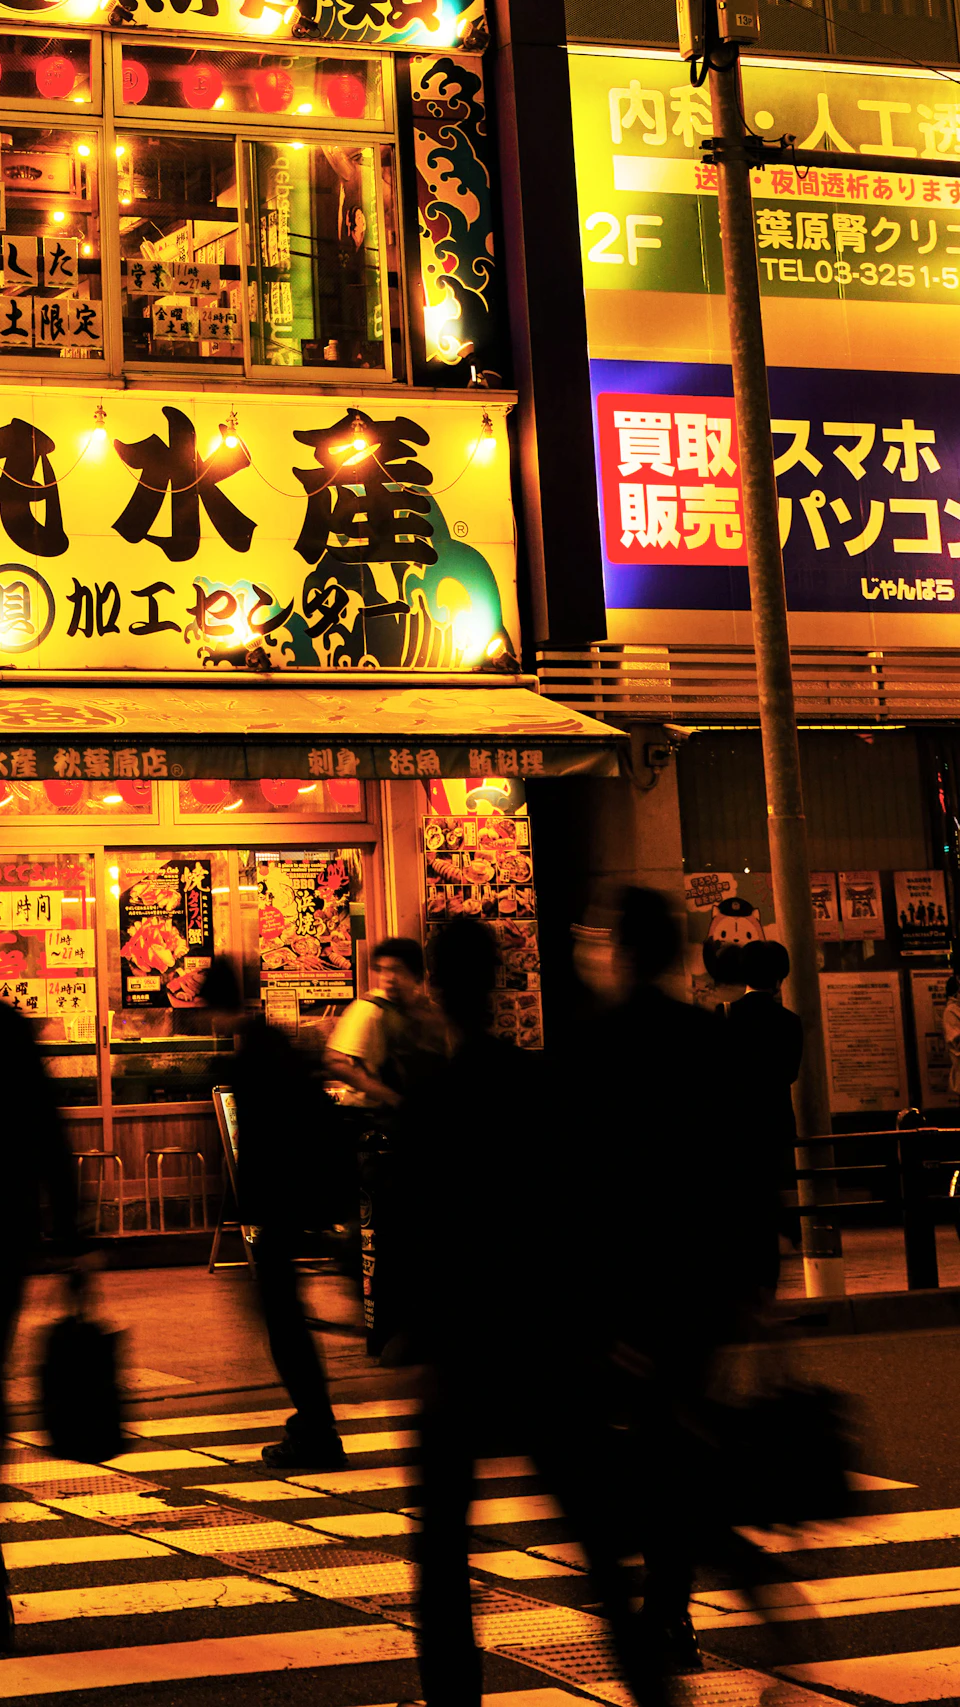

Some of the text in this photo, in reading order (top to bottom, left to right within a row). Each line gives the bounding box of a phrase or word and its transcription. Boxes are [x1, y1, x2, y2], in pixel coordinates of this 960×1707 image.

[695, 164, 960, 204] 送・夜間透析あります
[584, 211, 664, 266] 2F
[131, 262, 167, 290] 営業
[154, 307, 184, 321] 金曜
[201, 311, 238, 324] 24時間
[164, 321, 193, 335] 土曜
[207, 323, 234, 336] 営業
[613, 410, 738, 478] 買取
[769, 418, 941, 482] スマホ
[619, 483, 743, 550] 販売
[860, 576, 955, 602] じゃんぱら
[53, 747, 169, 779] 秋葉原店
[307, 748, 360, 778] 刺身
[389, 748, 441, 778] 活魚
[468, 748, 545, 778] 鮪料理
[180, 861, 211, 893] 焼
[292, 878, 315, 890] BBQ
[188, 890, 203, 945] タラバ蟹
[296, 890, 317, 936] 浜焼
[48, 932, 73, 947] 11時
[48, 983, 87, 995] 24時間
[55, 996, 81, 1009] 営業
[11, 996, 38, 1010] 土曜
